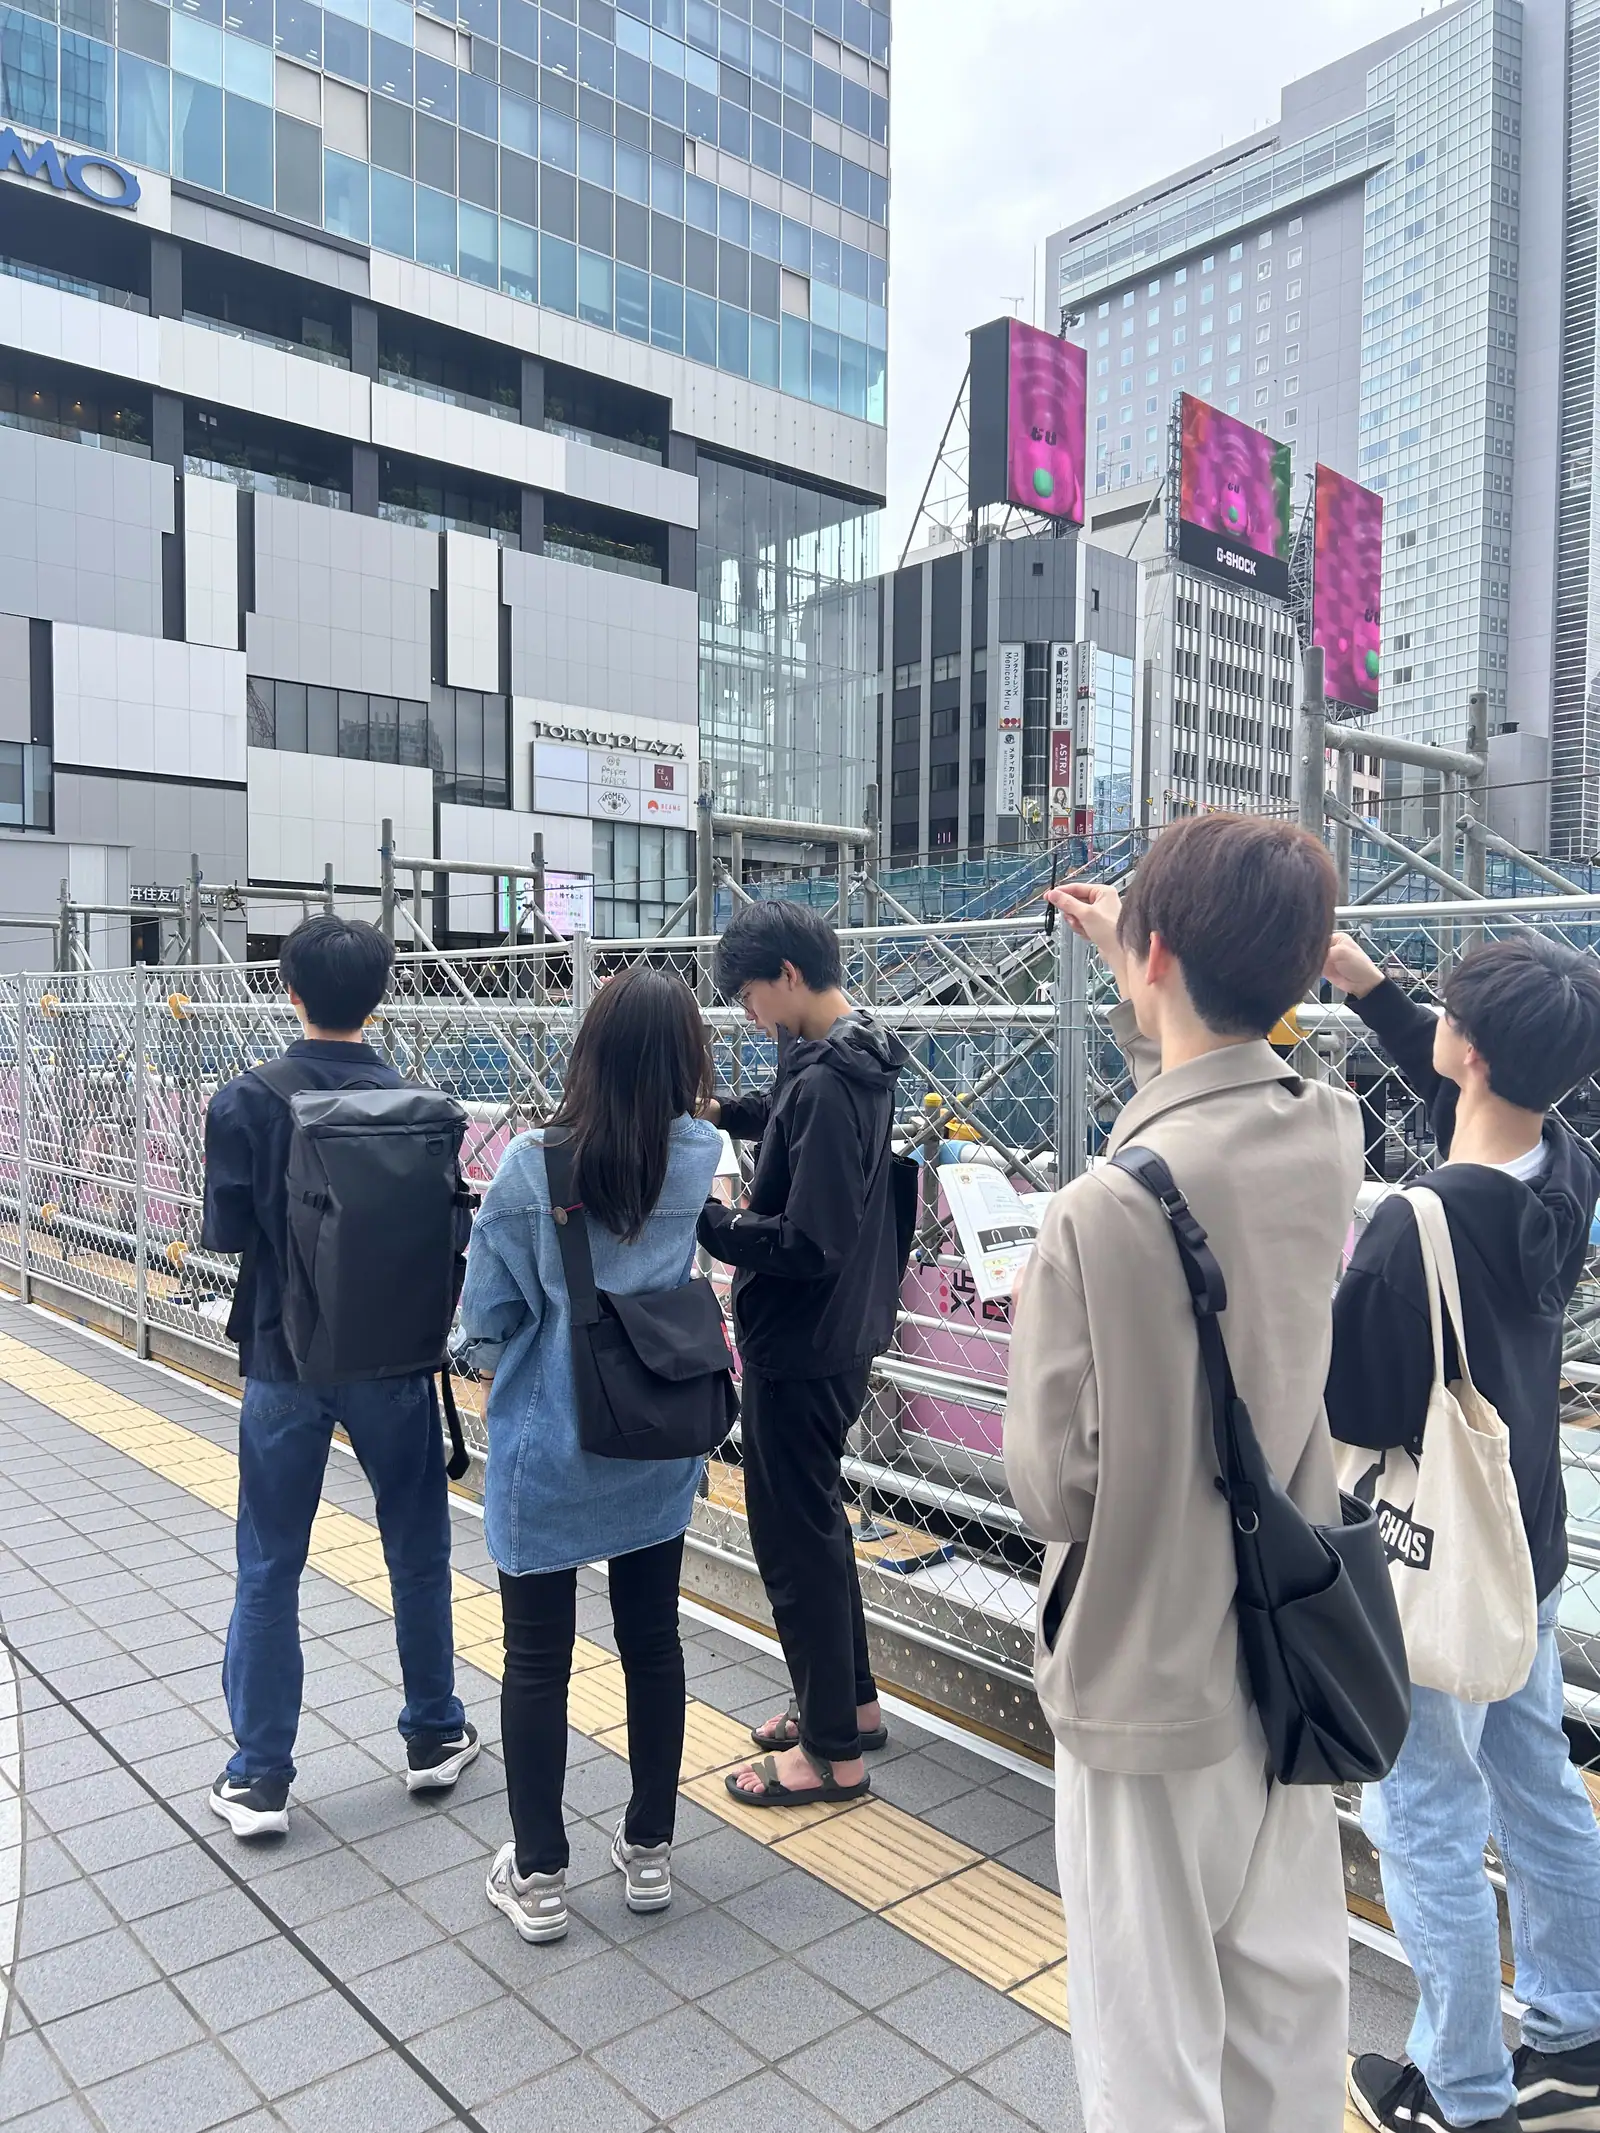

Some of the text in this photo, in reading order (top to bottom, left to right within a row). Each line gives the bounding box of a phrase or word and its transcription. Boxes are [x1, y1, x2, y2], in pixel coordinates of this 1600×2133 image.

[1216, 547, 1257, 576] G-SHOCK
[535, 720, 687, 757] TOKYU PLAZA
[1059, 743, 1067, 775] ASTRA
